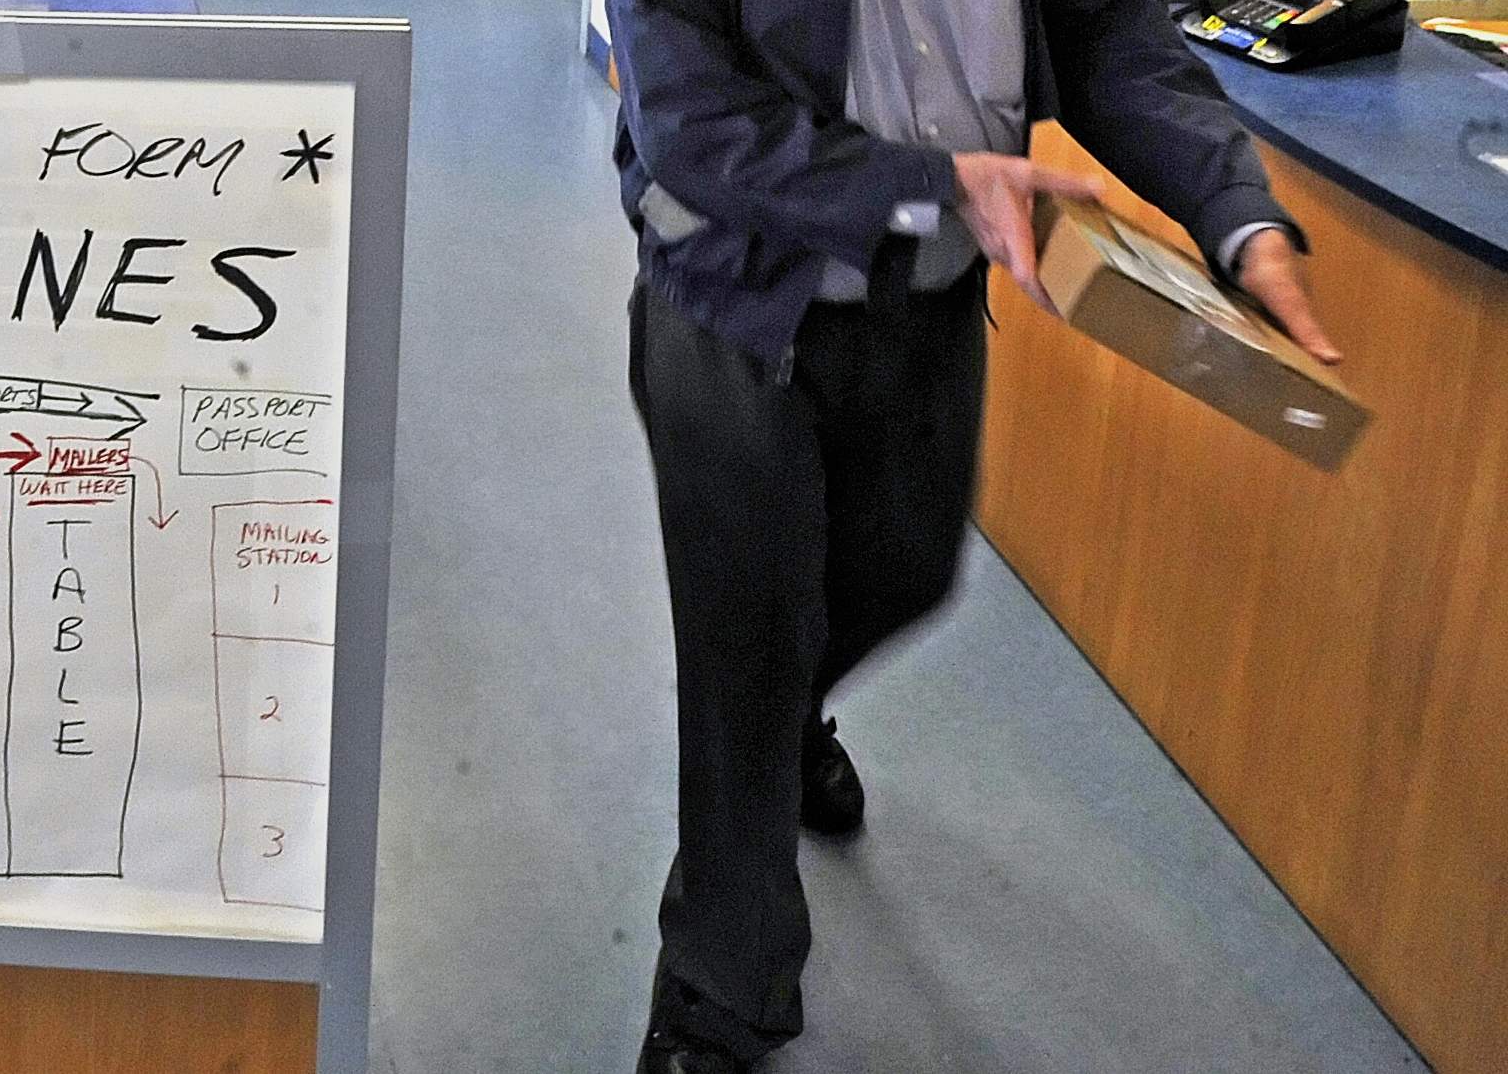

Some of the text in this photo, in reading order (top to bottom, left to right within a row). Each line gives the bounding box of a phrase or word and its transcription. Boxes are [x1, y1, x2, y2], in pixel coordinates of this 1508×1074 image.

[41, 123, 245, 196] FORM
[195, 427, 310, 455] OFFICE
[49, 445, 128, 471] MAILERS
[20, 478, 128, 497] WAIT HERE
[241, 522, 330, 546] MAILING
[236, 549, 332, 568] STATION
[46, 520, 93, 755] TABLE
[260, 696, 282, 722] 2
[261, 825, 285, 858] 3
